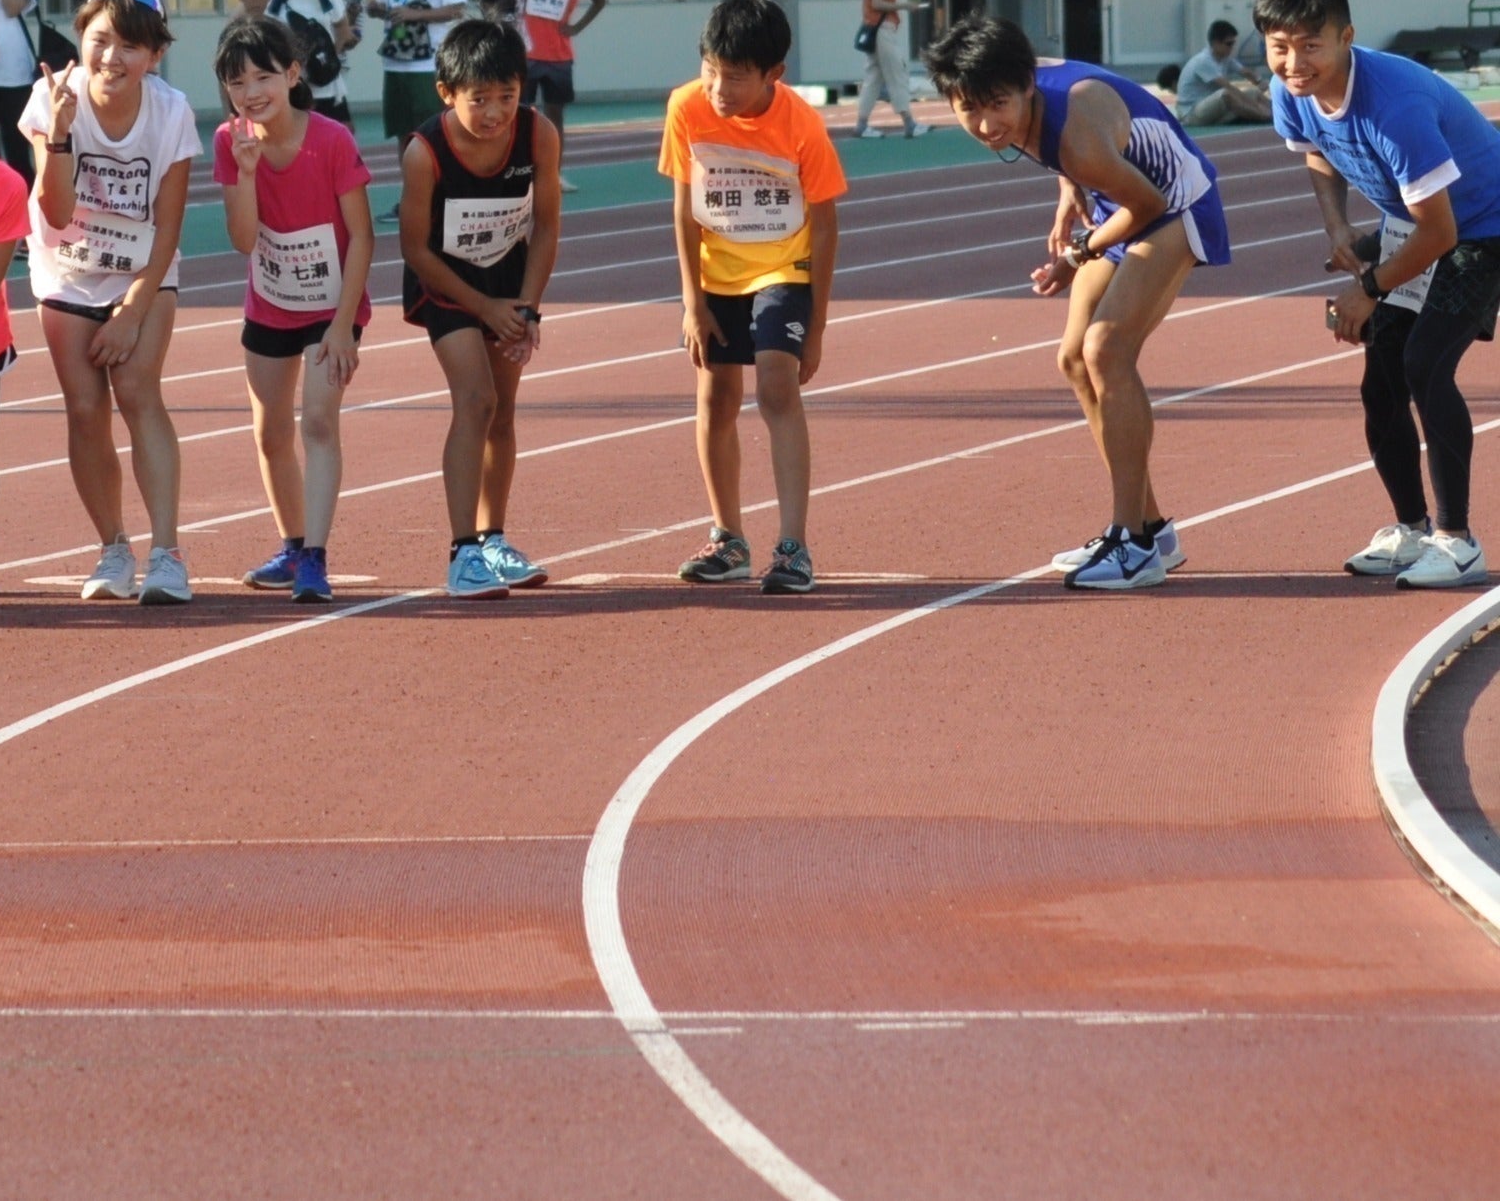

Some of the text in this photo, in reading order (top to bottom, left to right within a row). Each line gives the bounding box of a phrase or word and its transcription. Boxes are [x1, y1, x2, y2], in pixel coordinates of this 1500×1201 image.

[81, 161, 149, 180] yamazaru
[108, 183, 115, 195] T
[120, 185, 128, 195] &
[705, 188, 792, 208] 柳田 悠吾
[734, 223, 765, 232] RUNNING
[768, 223, 787, 231] CLUB
[291, 261, 329, 281] 七瀬
